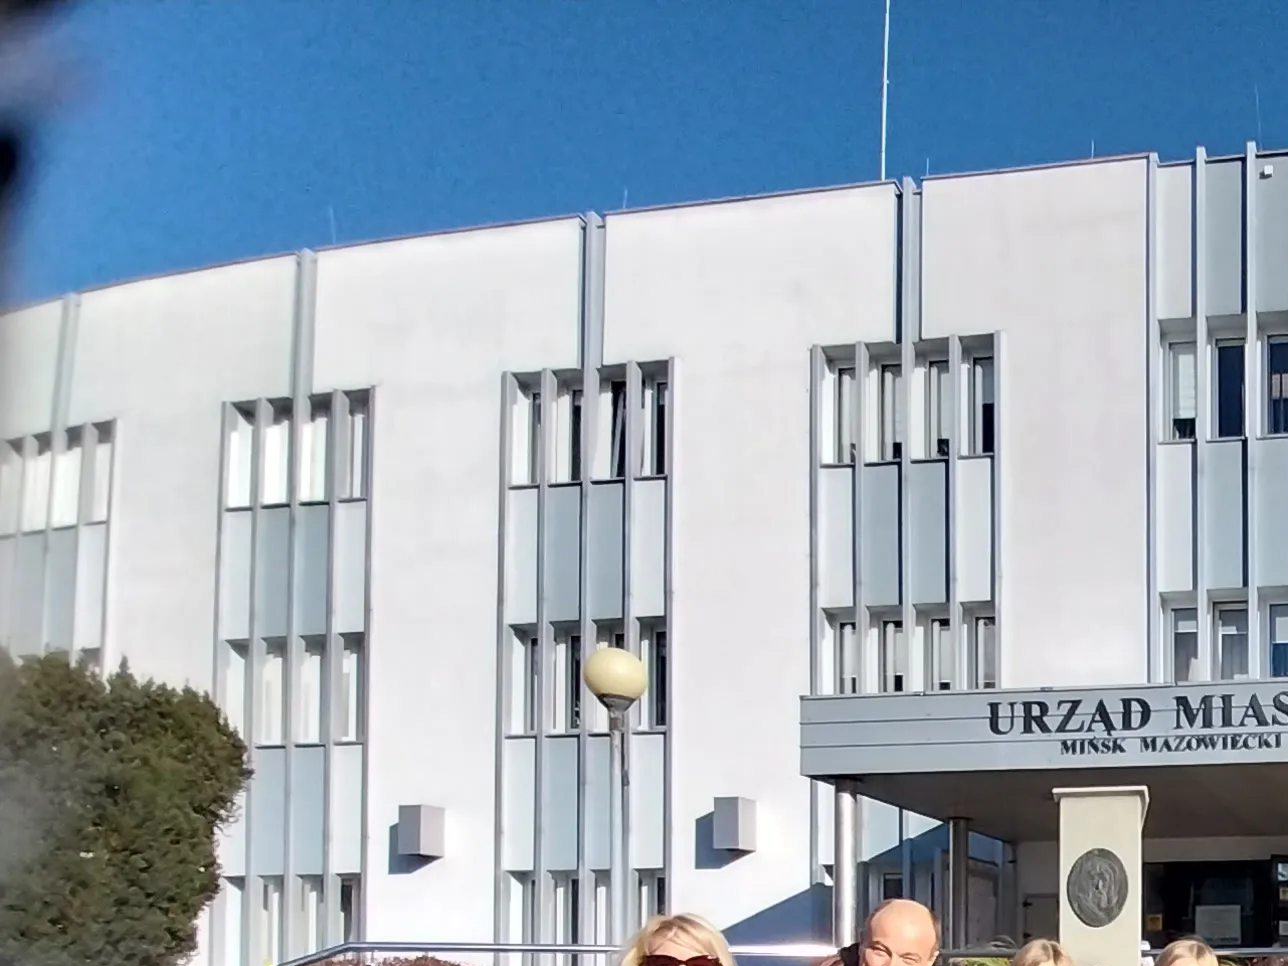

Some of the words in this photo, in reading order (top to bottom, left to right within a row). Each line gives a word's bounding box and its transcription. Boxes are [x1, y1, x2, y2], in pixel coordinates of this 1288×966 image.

[988, 697, 1152, 736] URZĄD
[1060, 735, 1127, 755] MIŃSK
[1139, 732, 1282, 753] MAZOWIECKI
